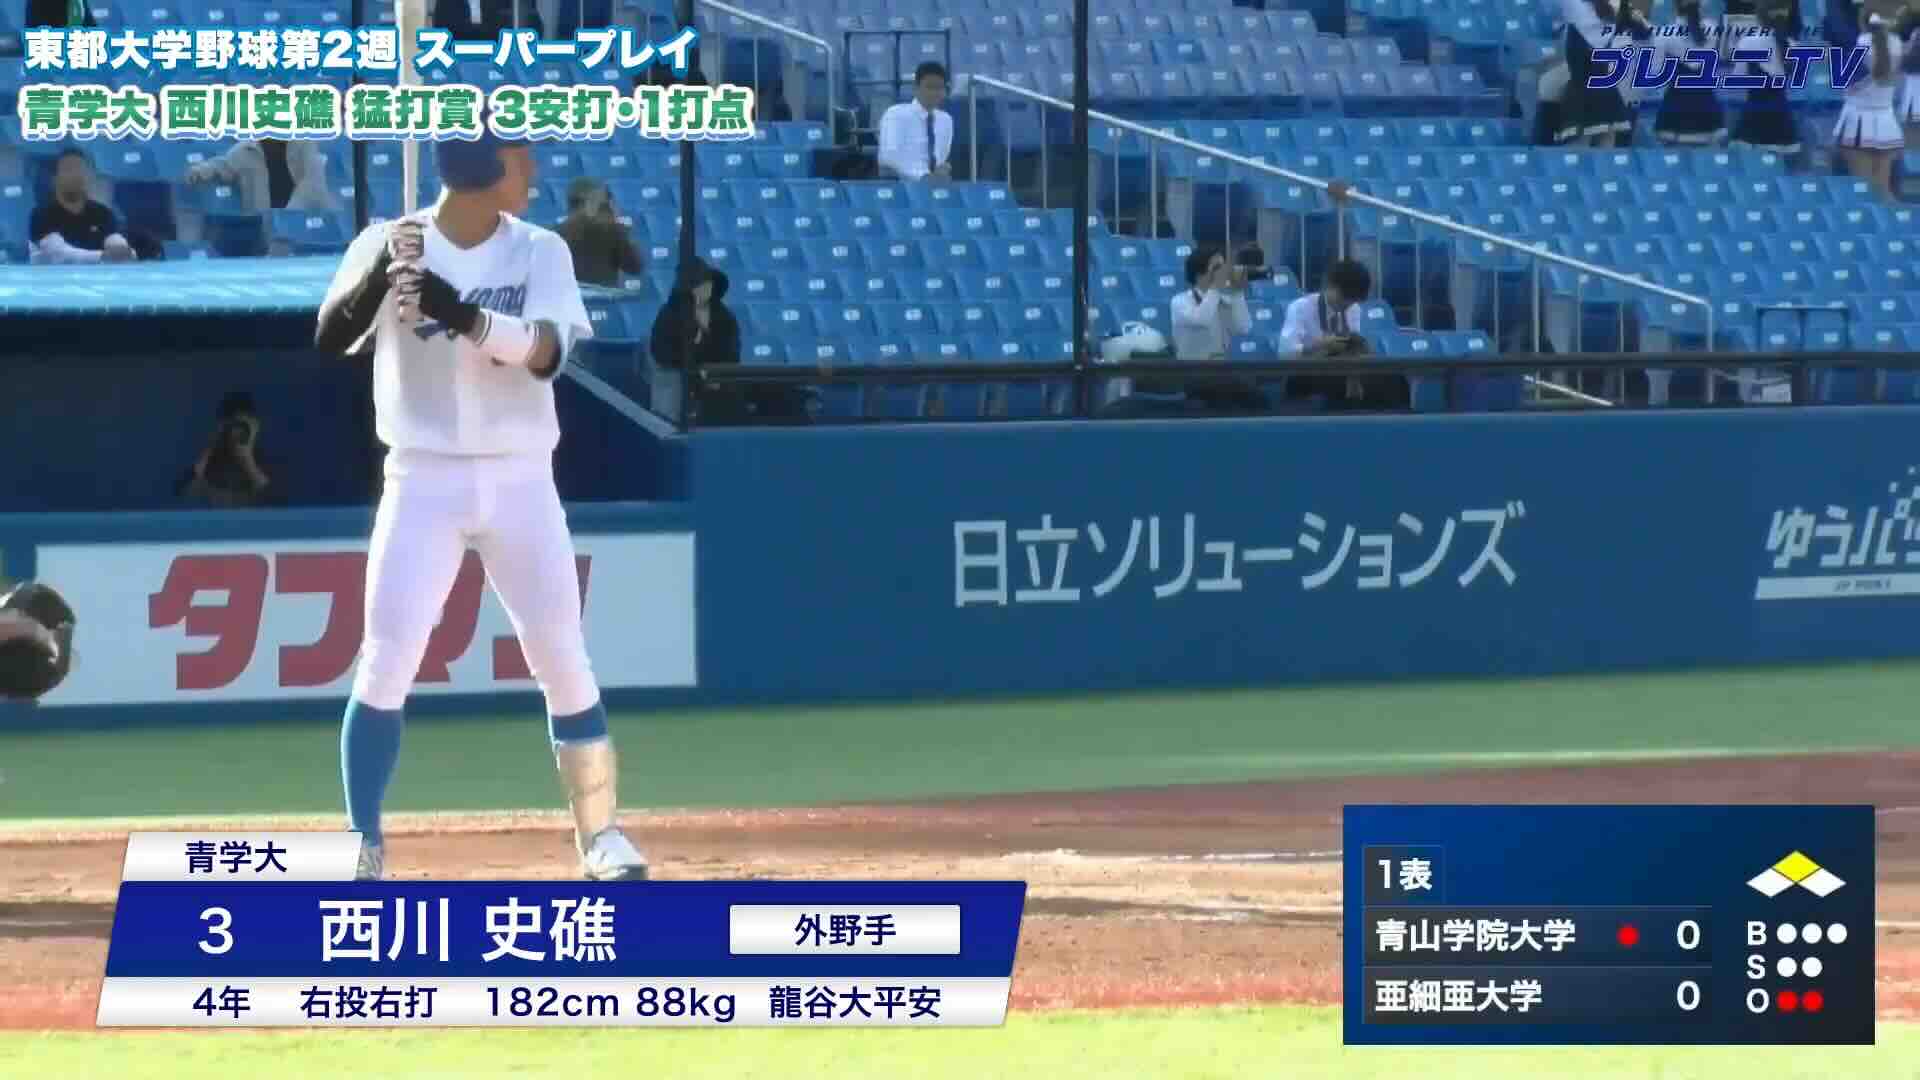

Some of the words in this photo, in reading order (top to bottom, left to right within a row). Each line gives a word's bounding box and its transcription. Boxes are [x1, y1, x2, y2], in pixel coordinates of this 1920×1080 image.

[953, 500, 1526, 607] 日立ソリューションズ
